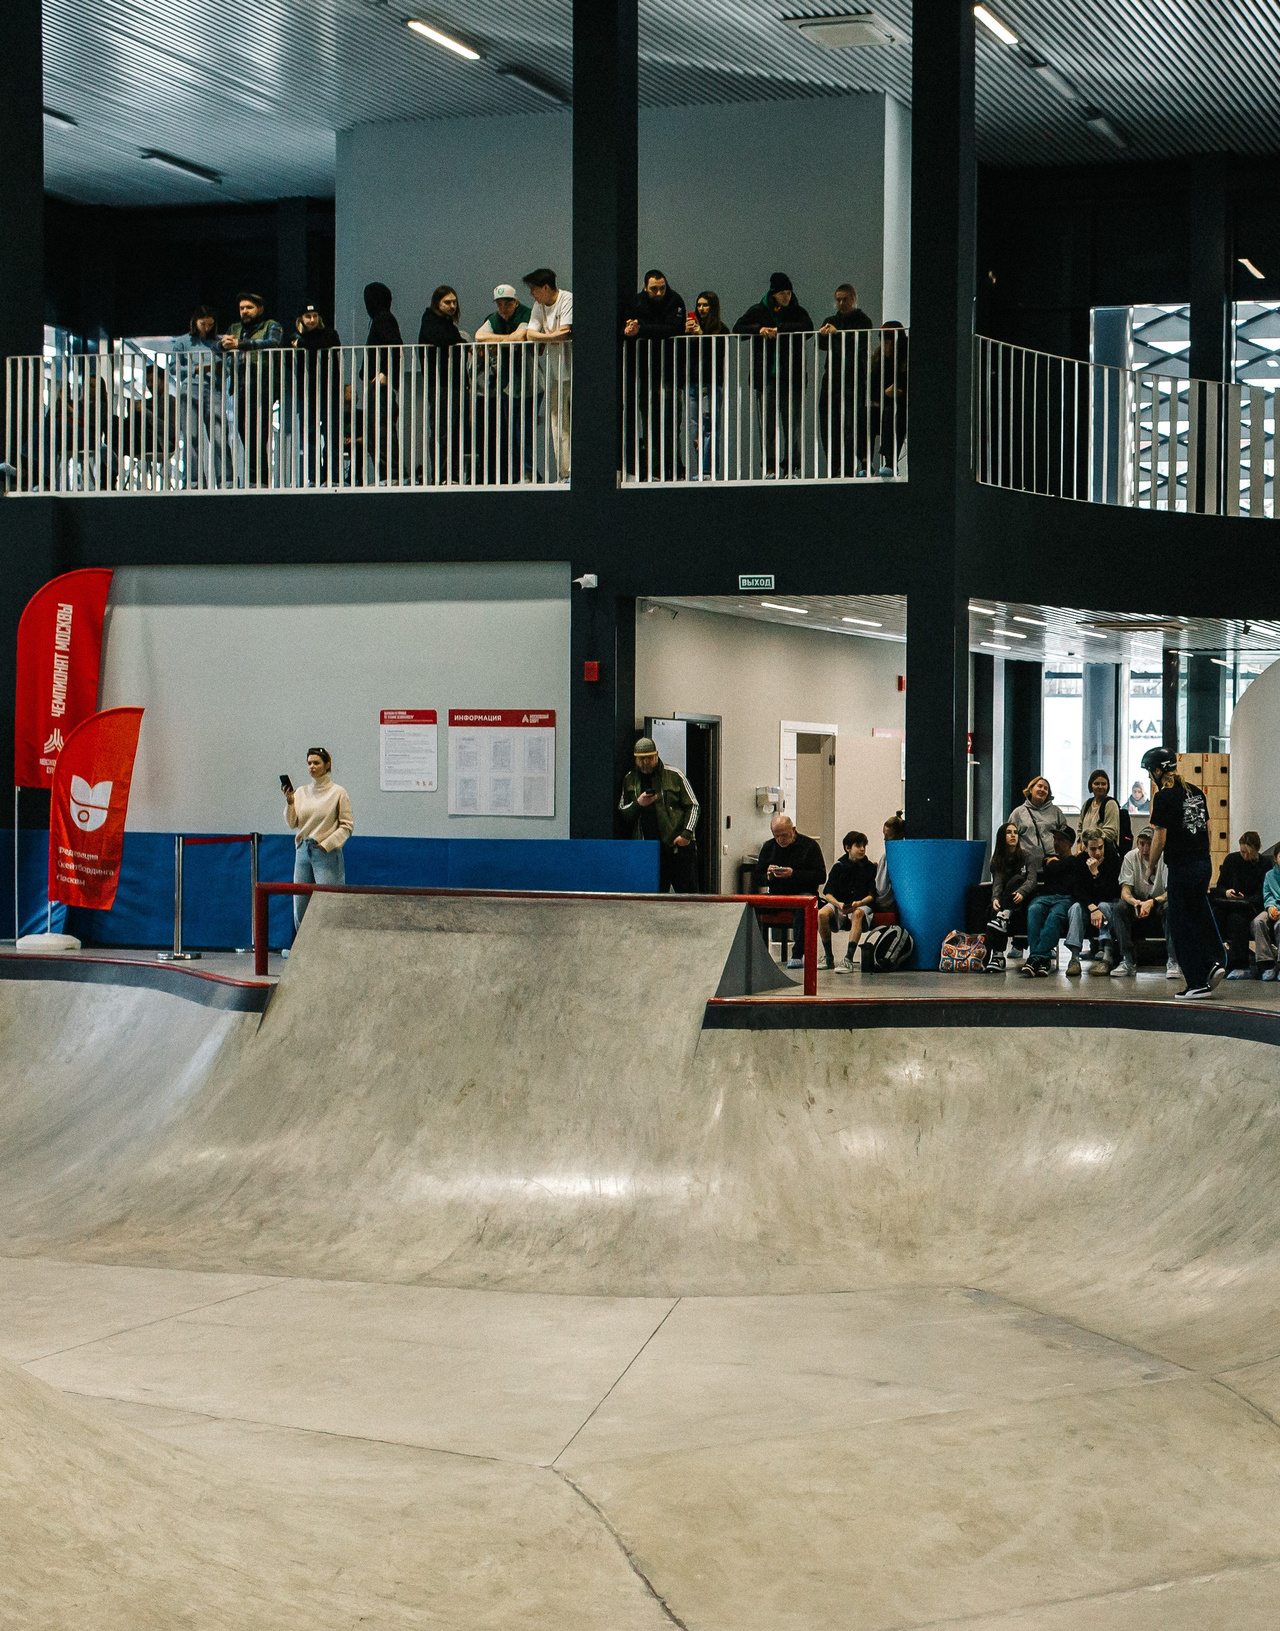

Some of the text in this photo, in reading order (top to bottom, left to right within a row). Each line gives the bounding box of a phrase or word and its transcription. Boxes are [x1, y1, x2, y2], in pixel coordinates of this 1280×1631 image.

[741, 578, 771, 587] ВЫХОД
[51, 602, 73, 718] ЧЕМПИОНАТ МОСКВЫ
[454, 714, 502, 722] ИНФОРМАЦИЯ
